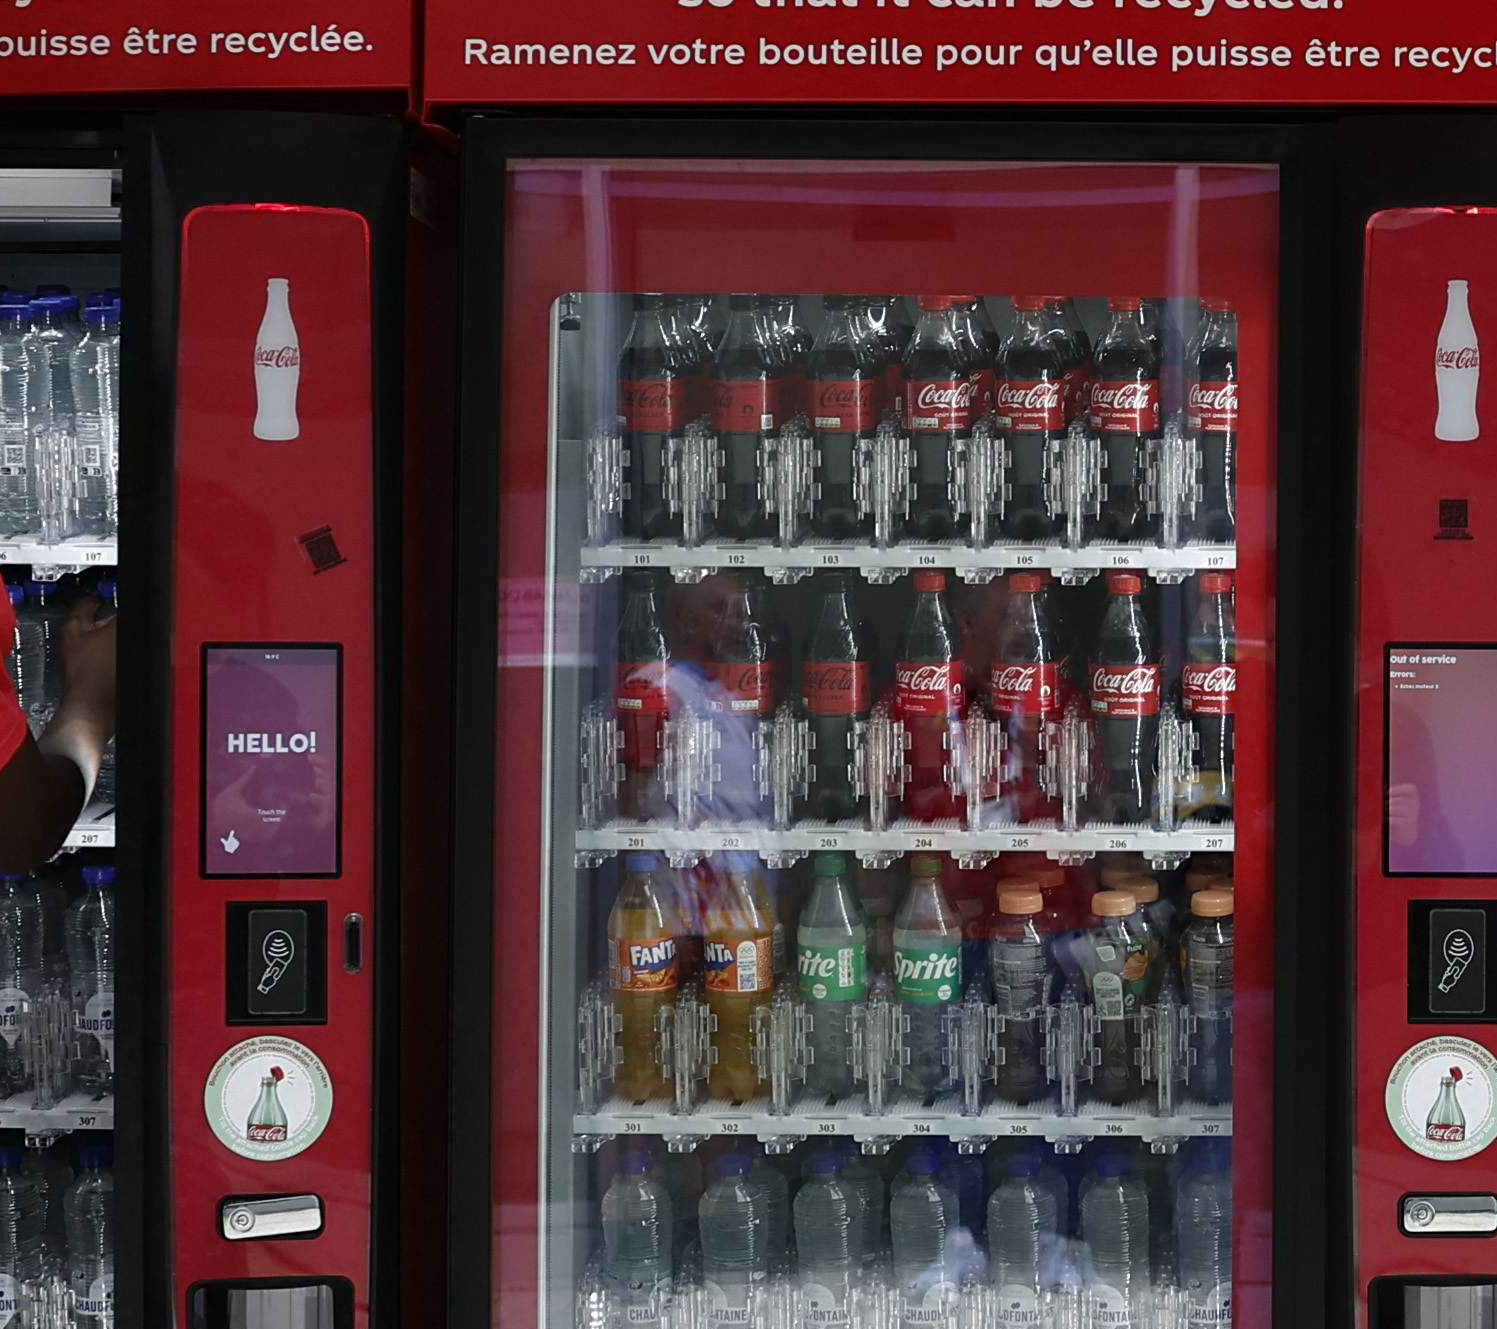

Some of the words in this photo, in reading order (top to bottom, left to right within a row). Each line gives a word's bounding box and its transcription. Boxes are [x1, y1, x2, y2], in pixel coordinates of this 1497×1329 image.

[123, 26, 198, 55] être
[210, 23, 373, 59] recyclée.
[464, 38, 636, 65] Ramenez
[647, 38, 746, 65] votre
[759, 37, 923, 66] bouteille
[936, 44, 1023, 71] pour
[1171, 38, 1292, 72] puisse
[1305, 38, 1381, 67] être
[254, 345, 300, 369] Coca-Cola
[1436, 346, 1480, 369] Coca-Cola
[997, 379, 1059, 409] Coca-Cola
[85, 552, 102, 561] 107
[633, 554, 651, 565] 101
[918, 555, 936, 566] 104
[1016, 555, 1033, 566] 105
[1112, 555, 1130, 566] 106
[1390, 655, 1407, 664] Out
[1409, 654, 1420, 664] of
[1421, 654, 1457, 664] service
[1093, 665, 1155, 694] Coca-Cola
[227, 731, 316, 753] HELLO!
[894, 950, 958, 979] Sprite
[249, 1125, 287, 1141] Coca-Cola
[912, 1124, 931, 1134] 304
[1105, 1124, 1123, 1134] 306
